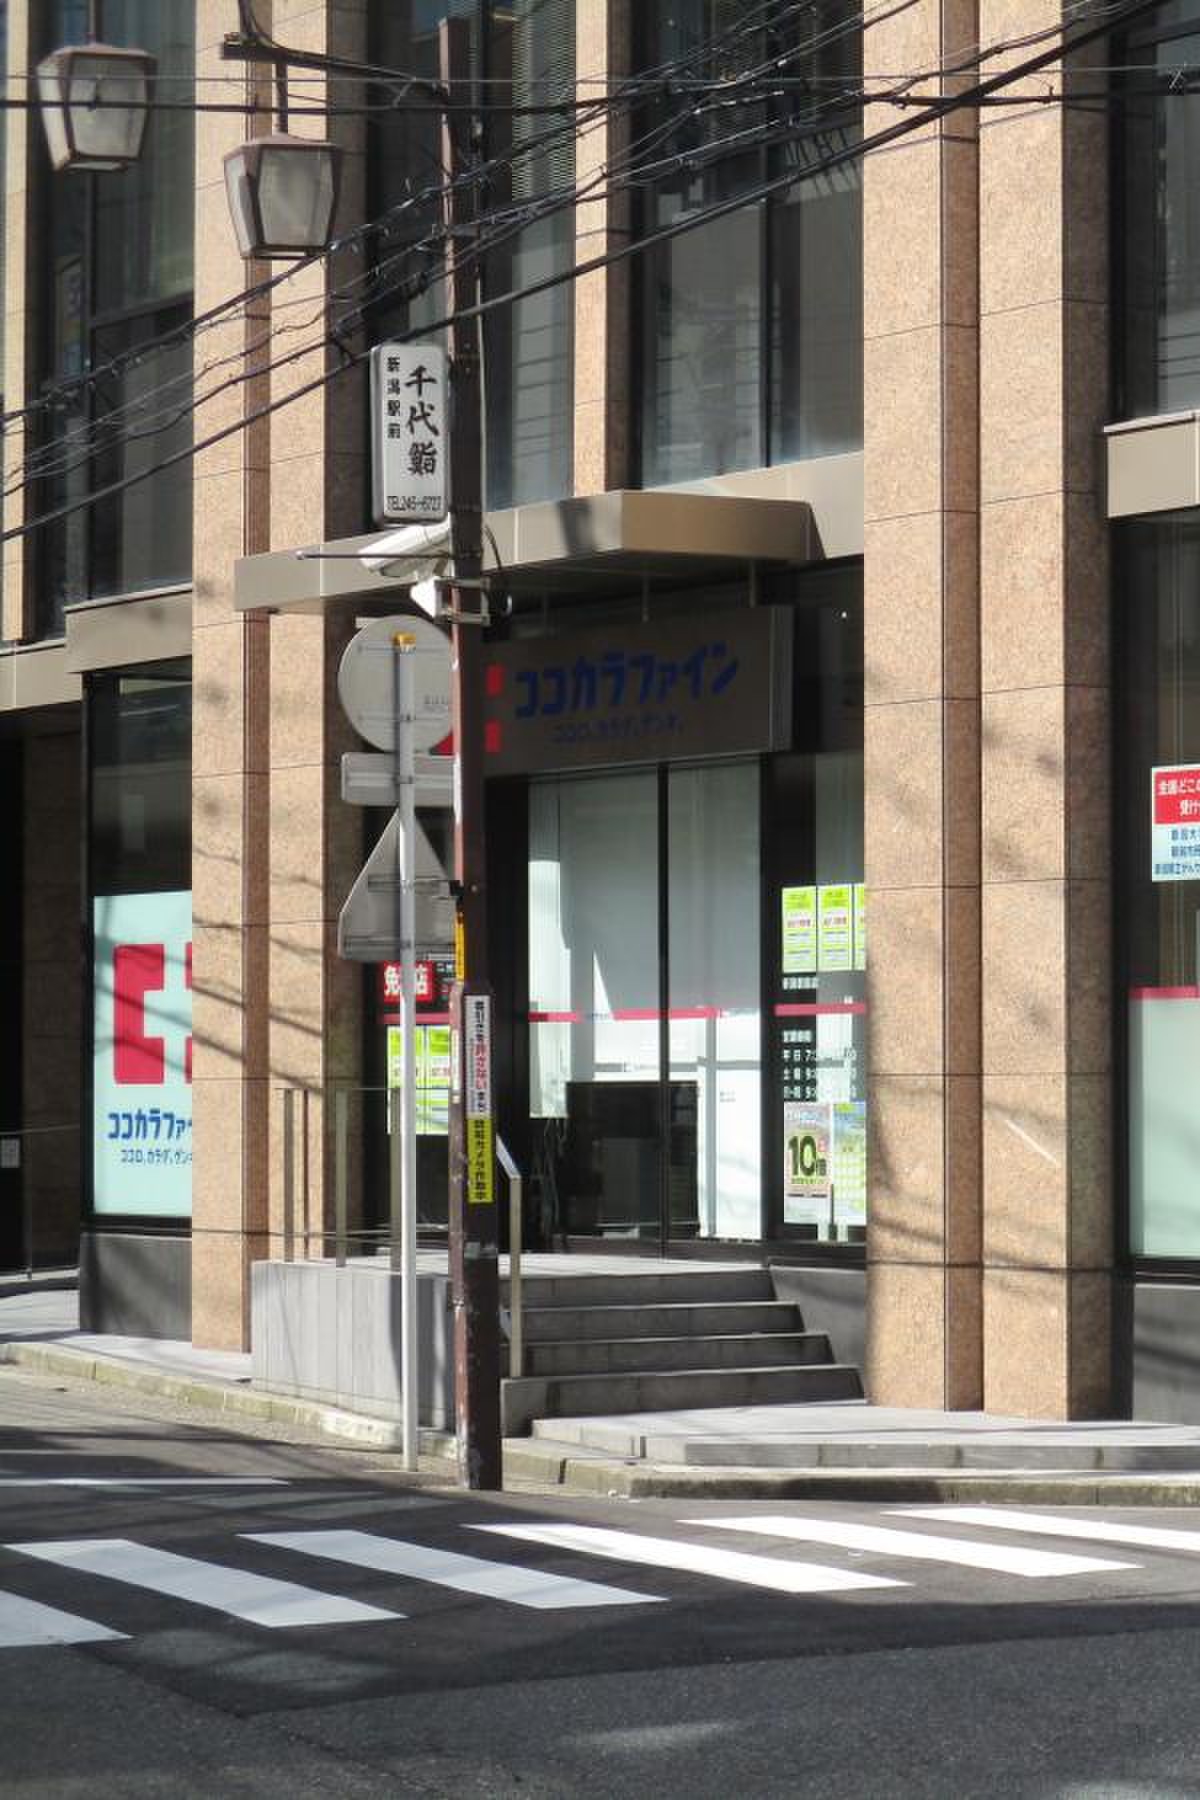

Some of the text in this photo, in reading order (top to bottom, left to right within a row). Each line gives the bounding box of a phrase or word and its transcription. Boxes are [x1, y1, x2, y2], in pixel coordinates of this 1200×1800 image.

[405, 364, 440, 476] 千代鮨
[514, 641, 739, 718] ココカラファイン
